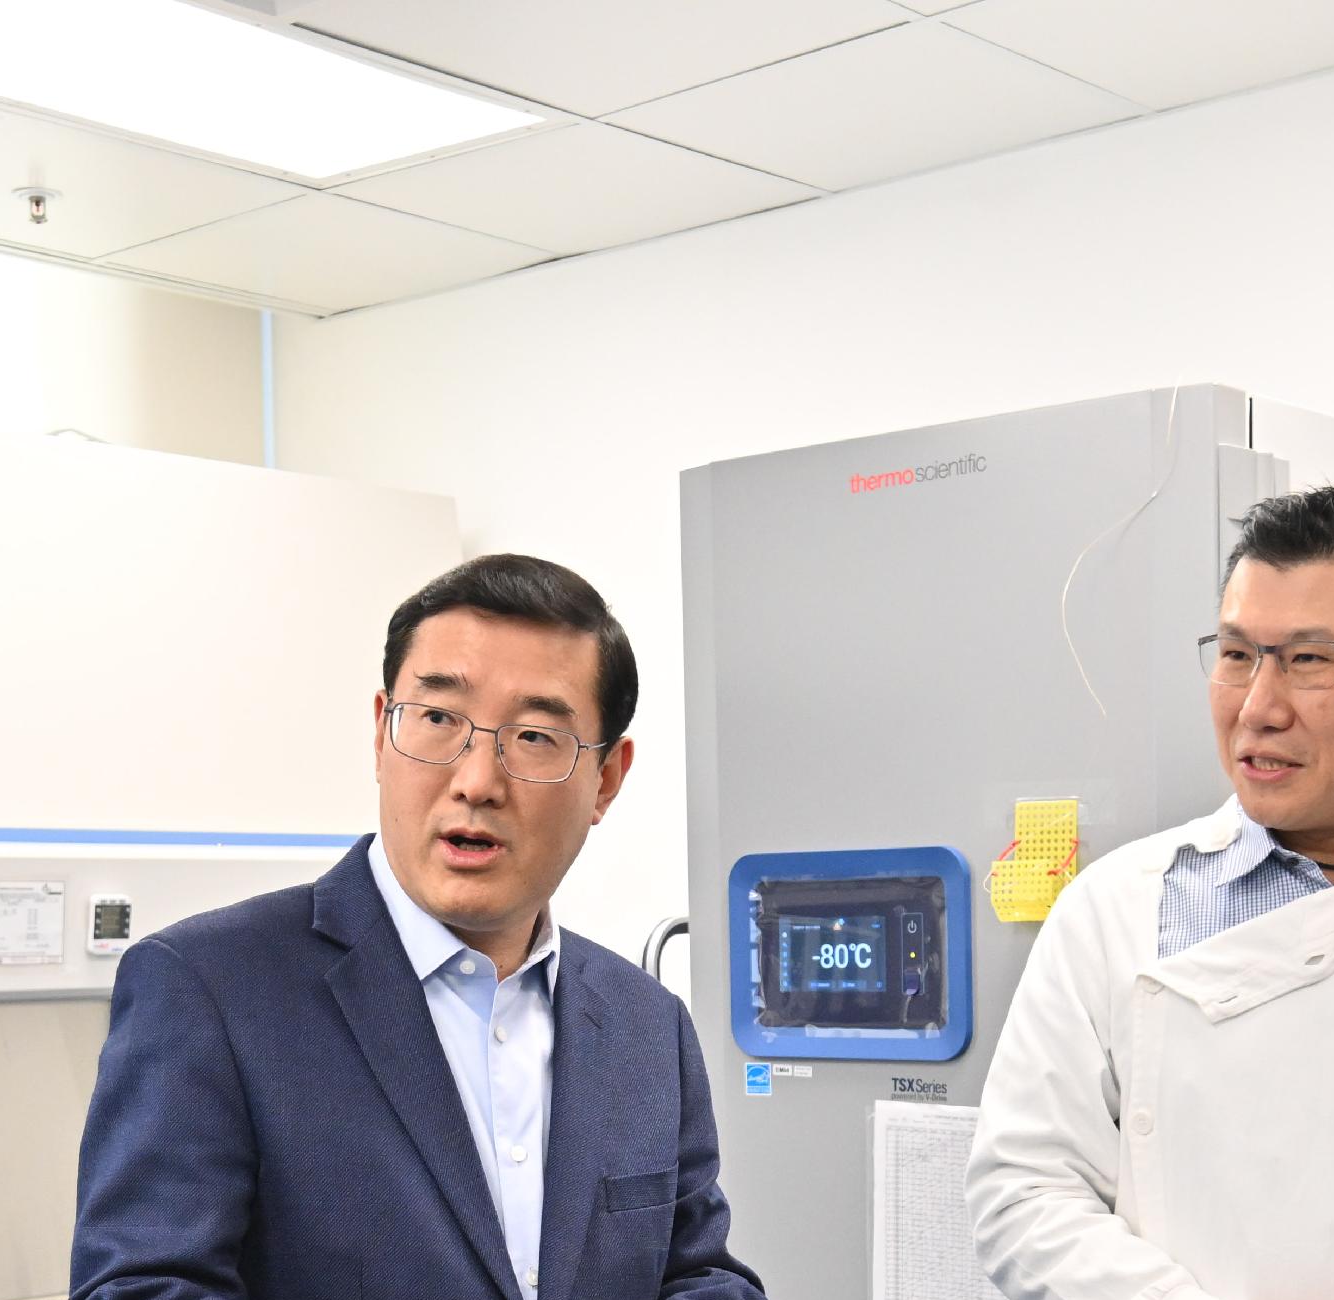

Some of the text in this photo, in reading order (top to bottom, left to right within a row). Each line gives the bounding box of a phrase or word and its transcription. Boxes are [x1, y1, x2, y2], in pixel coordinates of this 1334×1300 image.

[811, 943, 872, 969] -80°C
[892, 1077, 948, 1094] TSX Series
